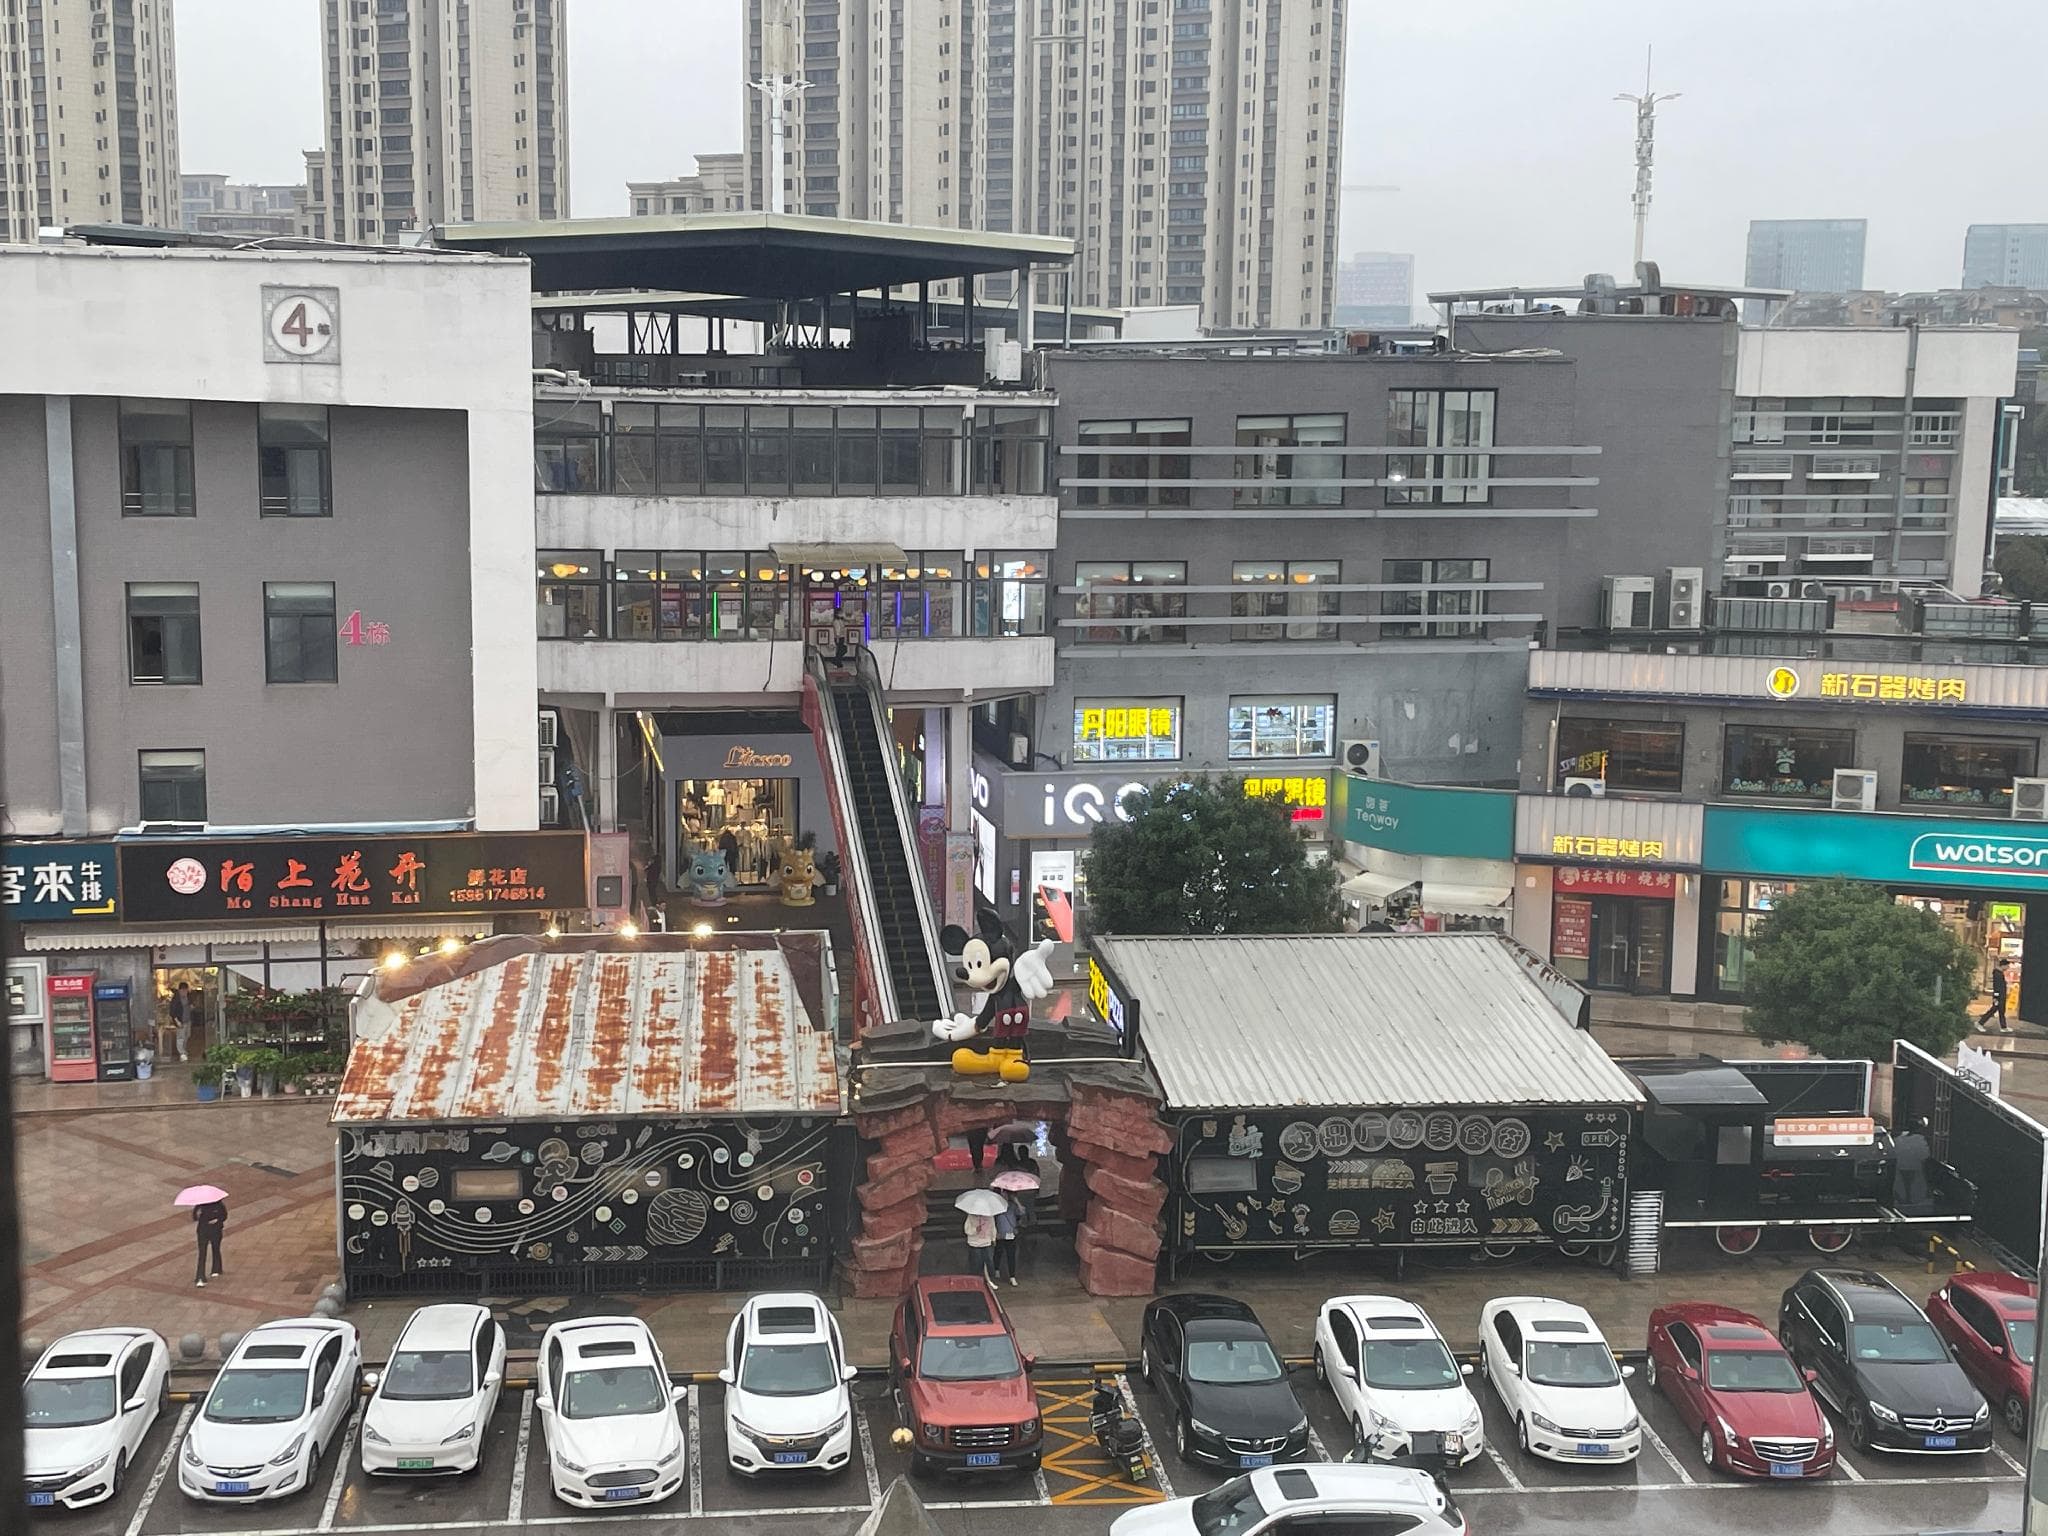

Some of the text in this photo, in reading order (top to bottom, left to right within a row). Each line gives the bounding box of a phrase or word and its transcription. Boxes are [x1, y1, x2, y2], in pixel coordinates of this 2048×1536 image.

[1820, 673, 1966, 702] 新石器烤肉
[1083, 708, 1171, 738] 丹阳眼镜
[1354, 807, 1399, 830] Tenway
[1553, 835, 1664, 859] 新石器烤肉
[80, 861, 102, 902] 牛排
[219, 850, 426, 893] 陌上花开
[467, 867, 528, 886] 鲜花店
[227, 891, 420, 909] Mo Shang Hua Kai
[1279, 1111, 1530, 1158] 文鼎广场美食街
[1583, 1134, 1610, 1143] OPEN
[1486, 1195, 1516, 1211] Menu
[1410, 1217, 1479, 1235] 由此进入
